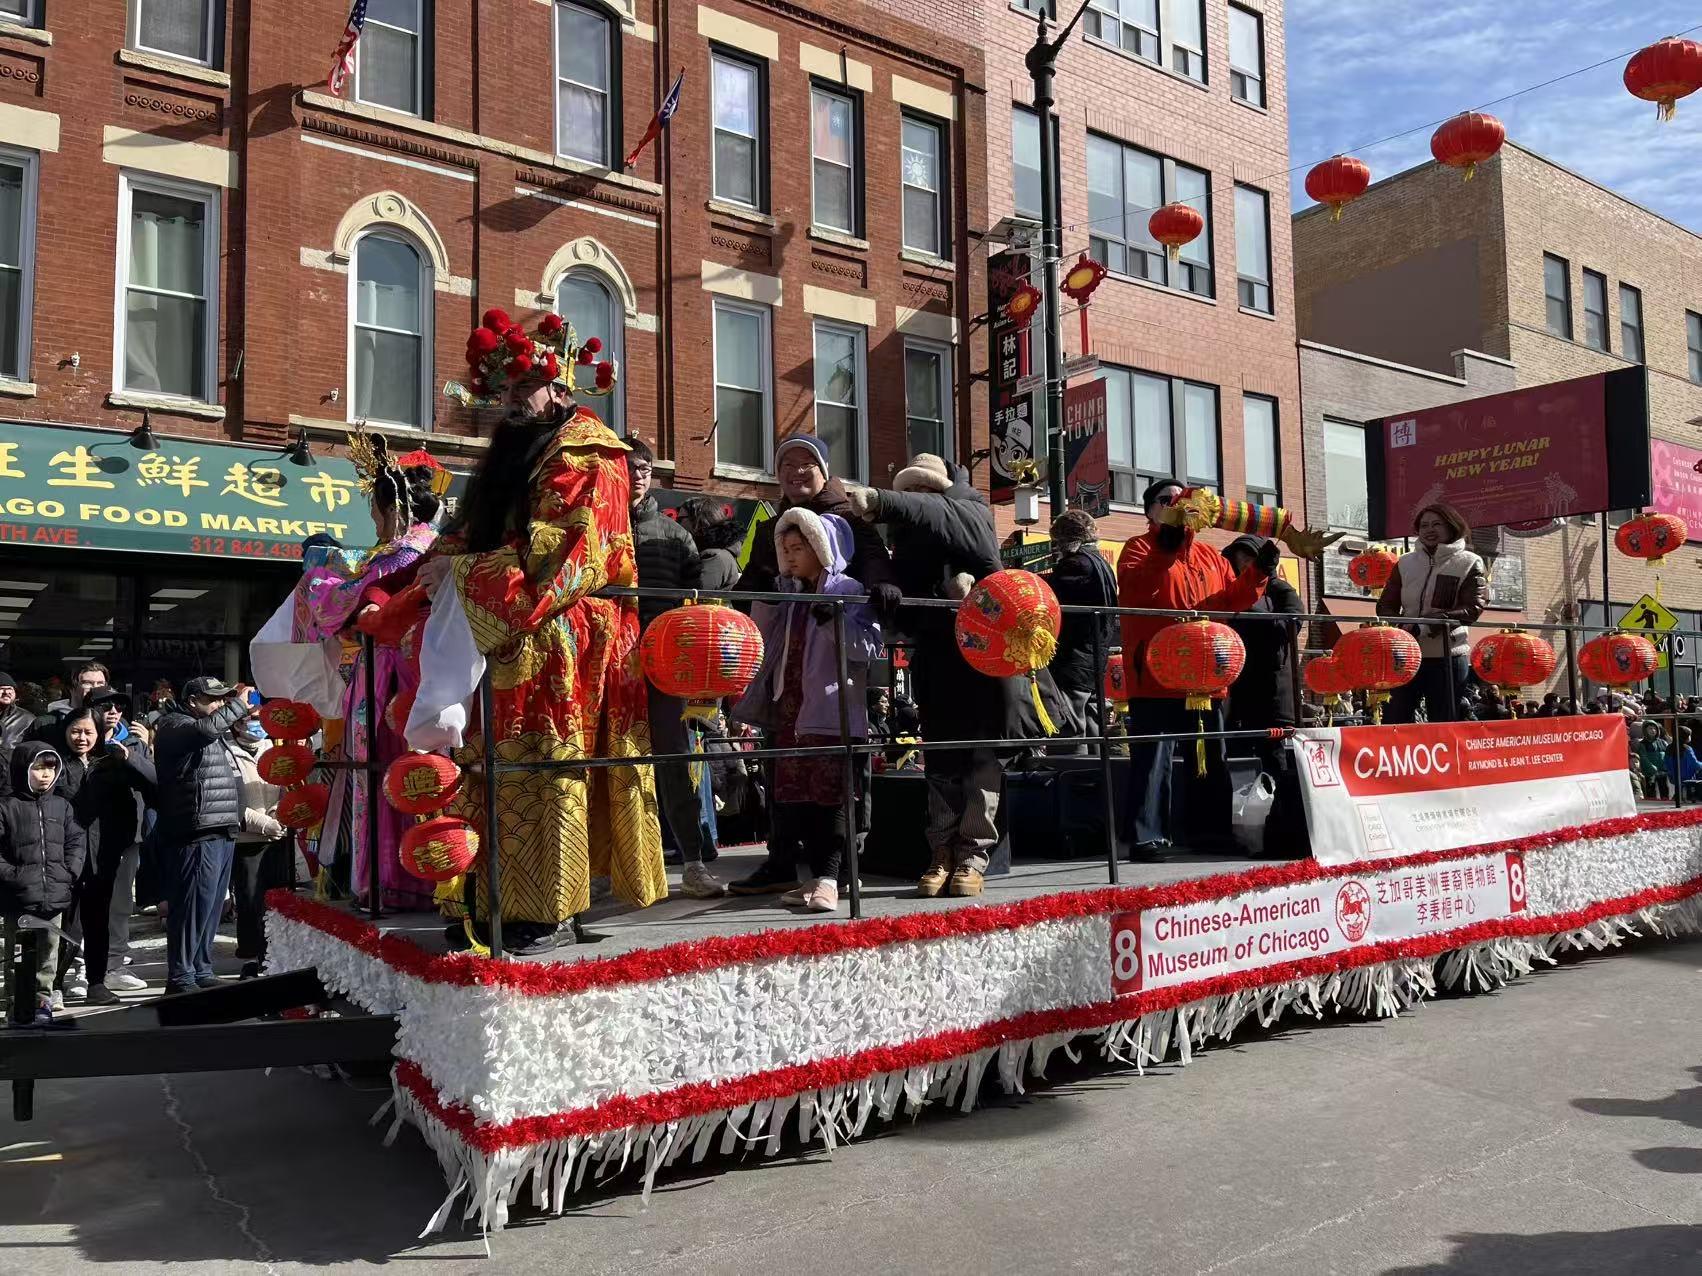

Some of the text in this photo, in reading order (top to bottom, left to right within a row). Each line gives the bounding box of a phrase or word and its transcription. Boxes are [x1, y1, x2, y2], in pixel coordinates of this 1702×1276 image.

[1002, 333, 1017, 380] 林記
[1067, 396, 1105, 424] CHINA
[1066, 414, 1105, 442] TOWN
[1434, 436, 1551, 467] HAPPY LUNAR
[1446, 453, 1540, 480] NEW YEAR!
[33, 526, 79, 545] AVE
[79, 503, 188, 527] FOOD
[200, 513, 348, 538] MARKET
[191, 536, 226, 555] 312
[1002, 544, 1041, 560] ALEXANDER
[1465, 728, 1604, 750] CHINESE AMERICAN MUSEUM OF CHICAGO
[1353, 741, 1451, 780] CAMOC
[1467, 759, 1499, 771] RAYMOND
[1508, 755, 1526, 767] JEAN
[1531, 754, 1542, 765] LEE
[1541, 752, 1564, 764] CENTER
[1375, 863, 1497, 905] 芝加哥美洲華裔博物館
[1509, 862, 1525, 903] 8
[1155, 896, 1320, 941] Chinese-American
[1416, 894, 1477, 926] 李秉樞中心
[1113, 928, 1139, 981] 8
[1147, 945, 1228, 979] Museum
[1234, 935, 1254, 960] of
[1257, 927, 1330, 955] Chicago
